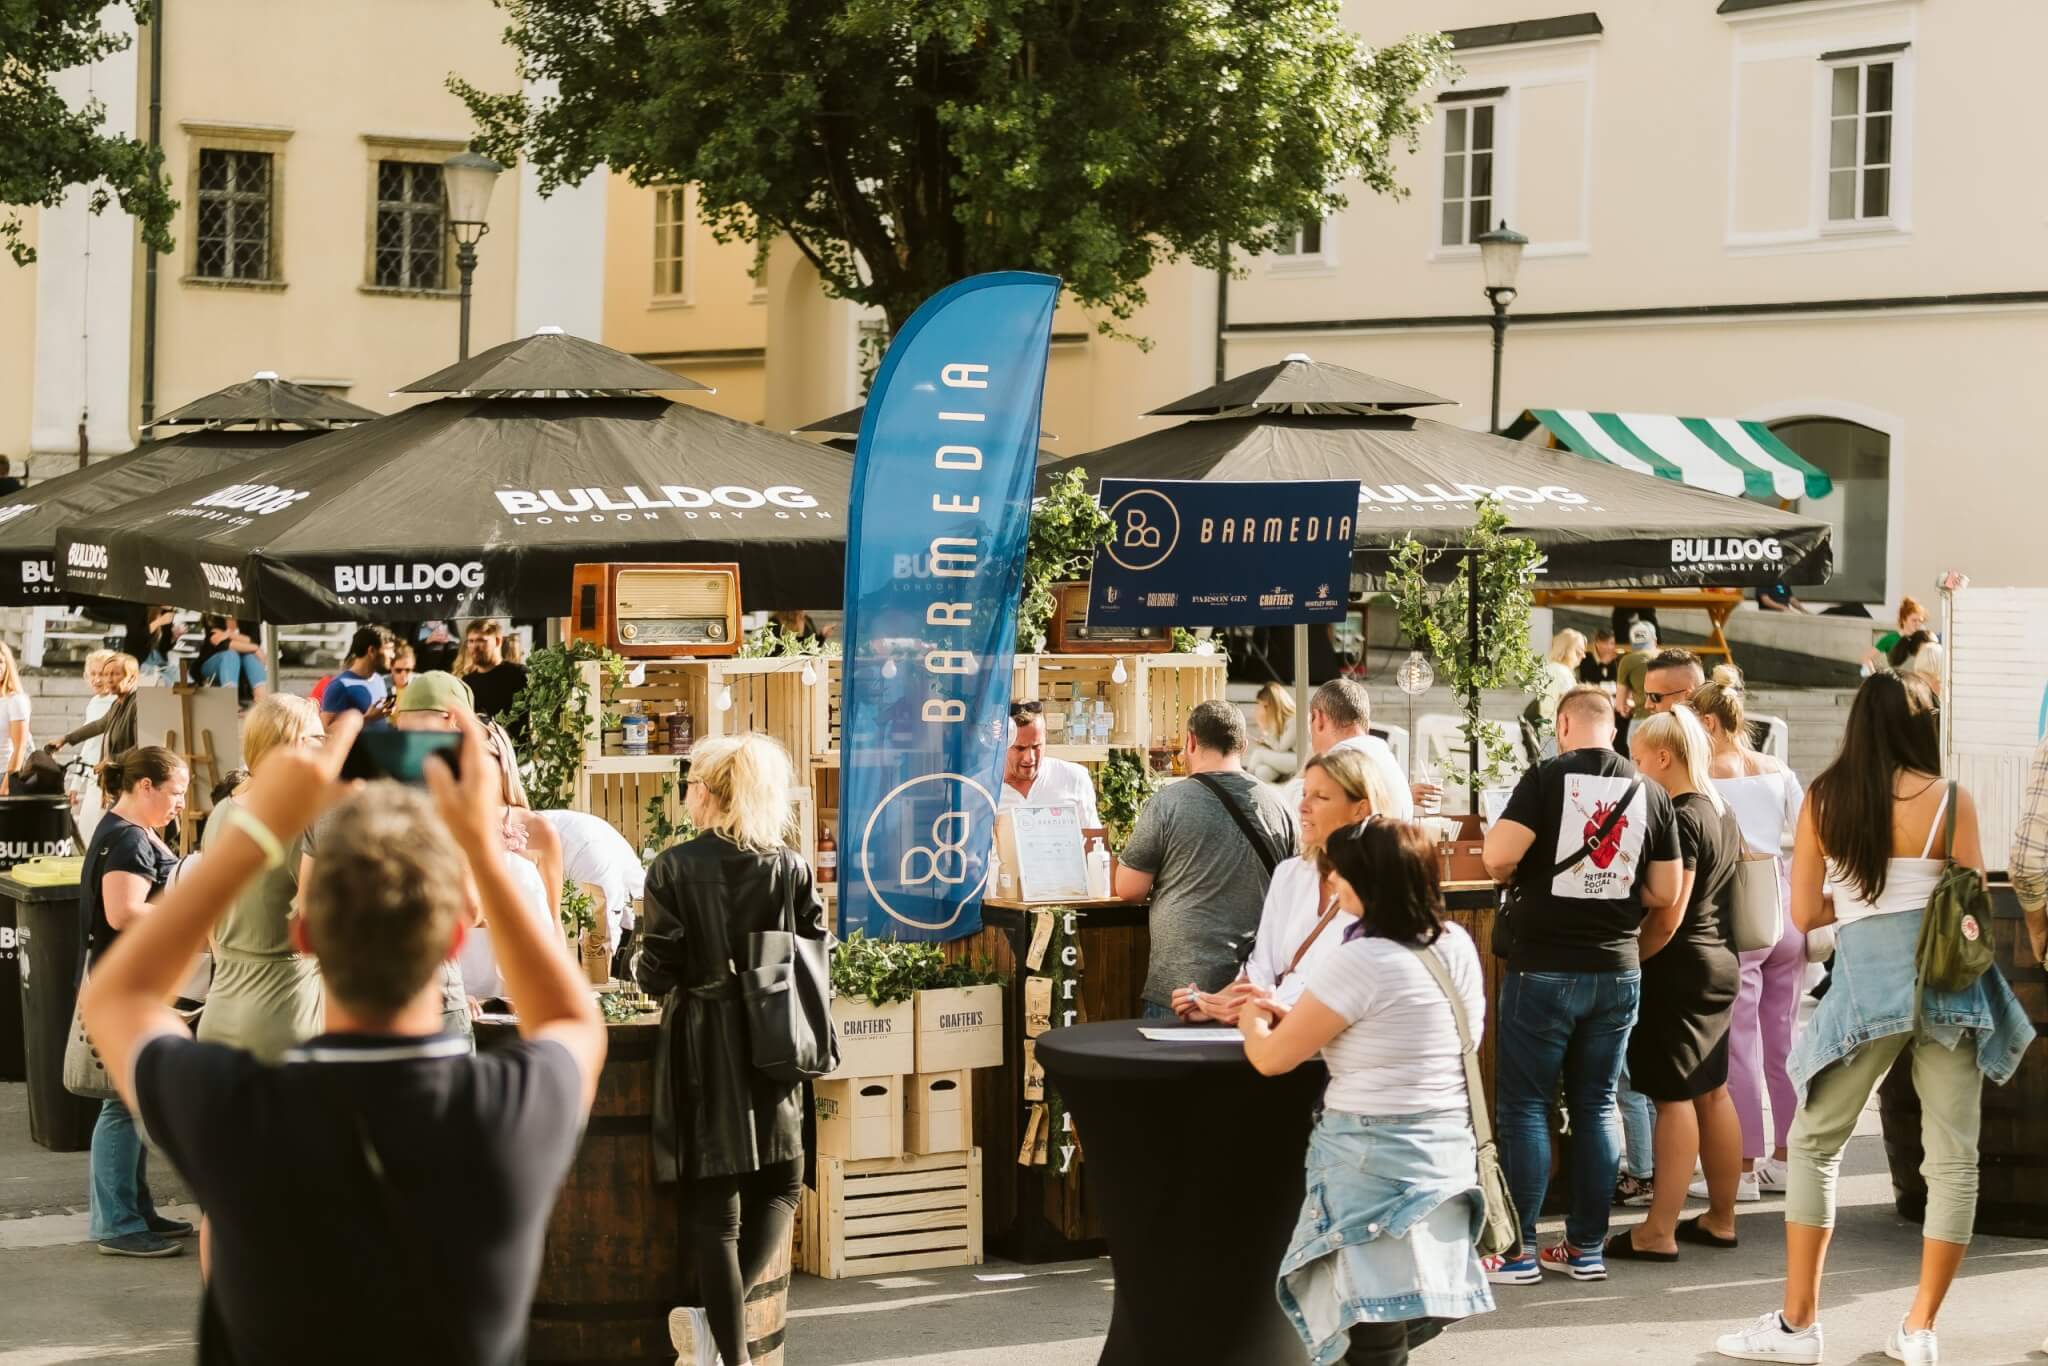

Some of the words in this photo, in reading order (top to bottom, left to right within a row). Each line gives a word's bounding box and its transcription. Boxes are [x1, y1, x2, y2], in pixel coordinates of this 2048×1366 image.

[191, 484, 311, 515] BULLDOG
[494, 485, 819, 515] BULLDOG
[513, 511, 661, 526] LONDON
[685, 510, 744, 520] DRY
[774, 510, 833, 520] GIN
[1200, 515, 1351, 544] BARMEDIA
[921, 361, 990, 723] BARMEDIA
[1671, 537, 1784, 563] BULLDOG
[67, 542, 109, 569] BULLDOG
[1671, 563, 1725, 573] LONDON
[1763, 563, 1785, 572] GIN
[334, 562, 485, 592] BULLDOG
[337, 594, 404, 605] LONDON
[414, 593, 444, 604] DRY
[456, 592, 486, 602] GIN
[843, 1018, 892, 1035] CRAFTER'S
[940, 1011, 983, 1029] CRAFTER'S
